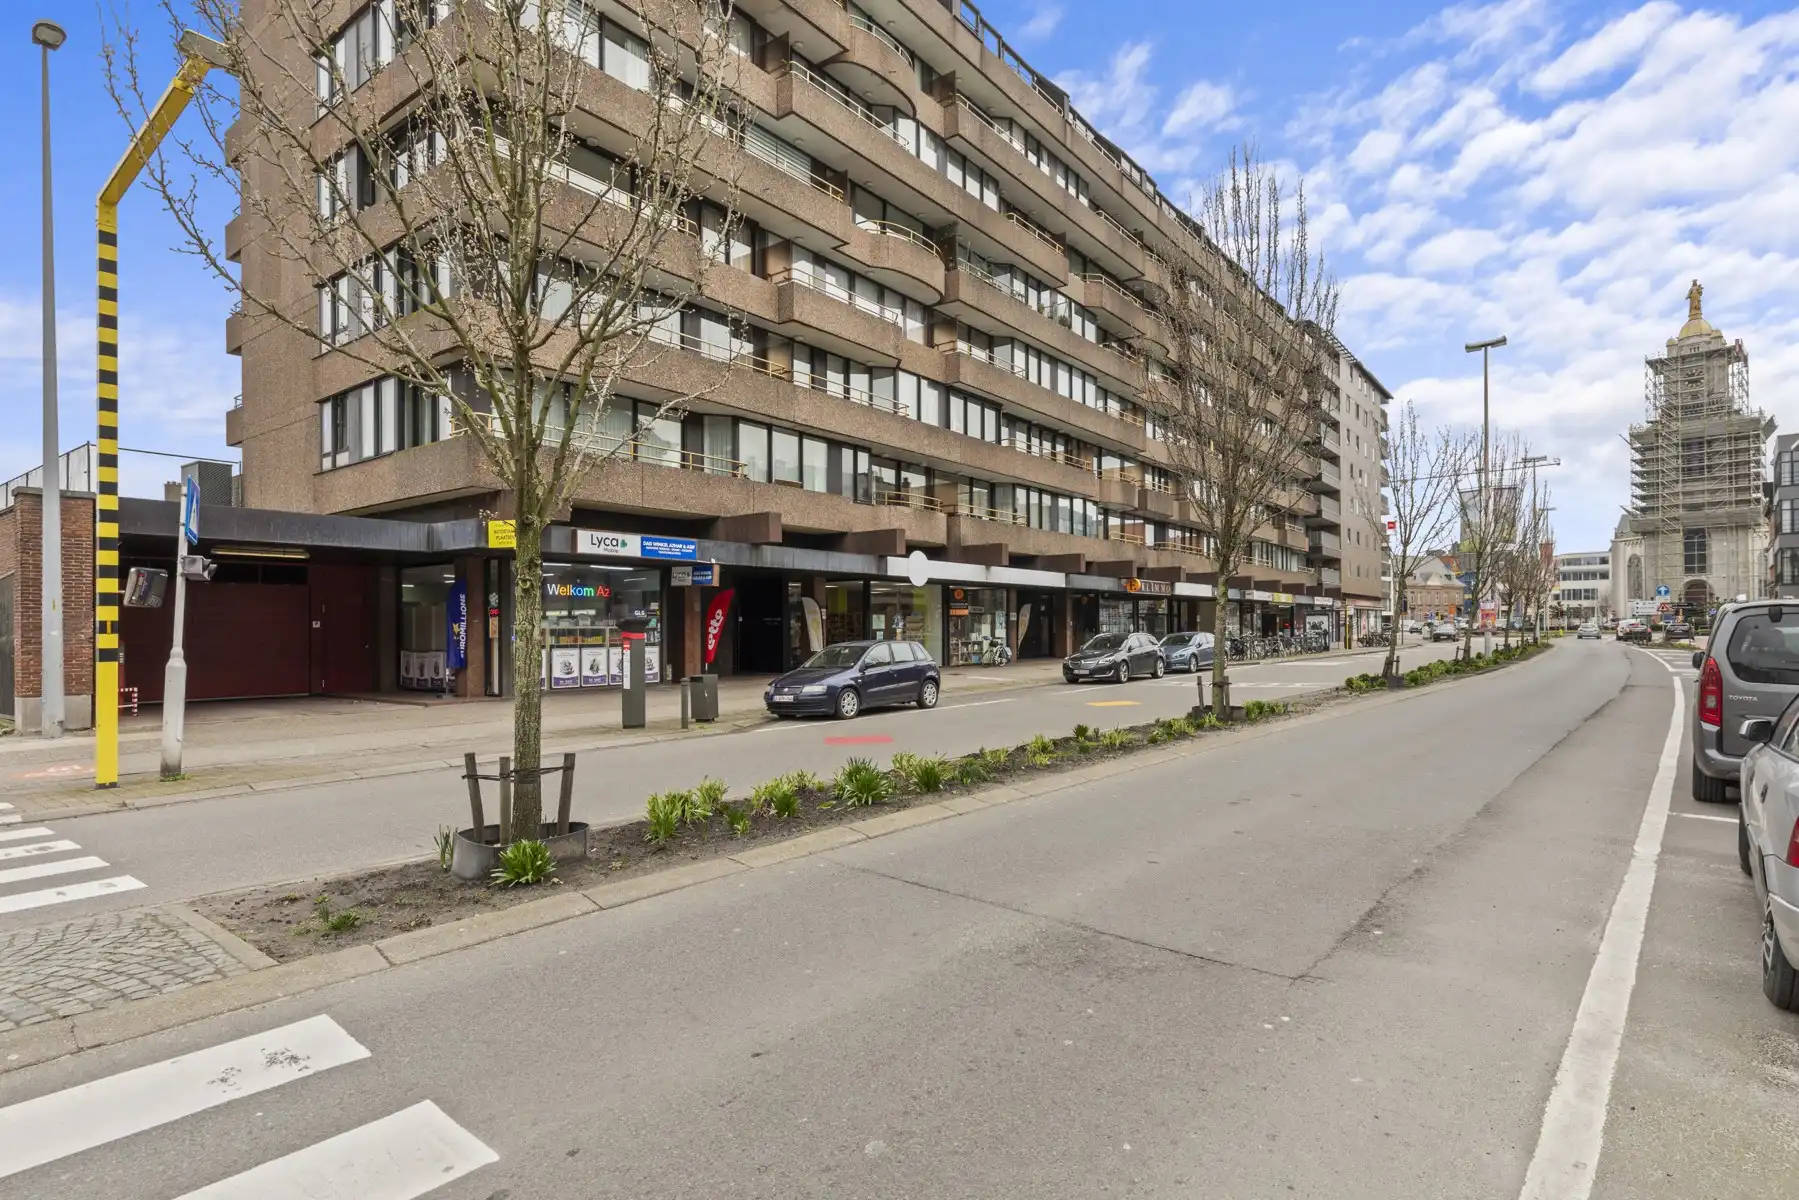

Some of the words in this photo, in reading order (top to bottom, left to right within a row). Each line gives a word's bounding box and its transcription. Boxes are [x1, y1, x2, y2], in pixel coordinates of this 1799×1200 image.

[590, 533, 619, 548] Lyca
[547, 583, 594, 597] Welkom
[1728, 694, 1758, 702] TOYOTA
